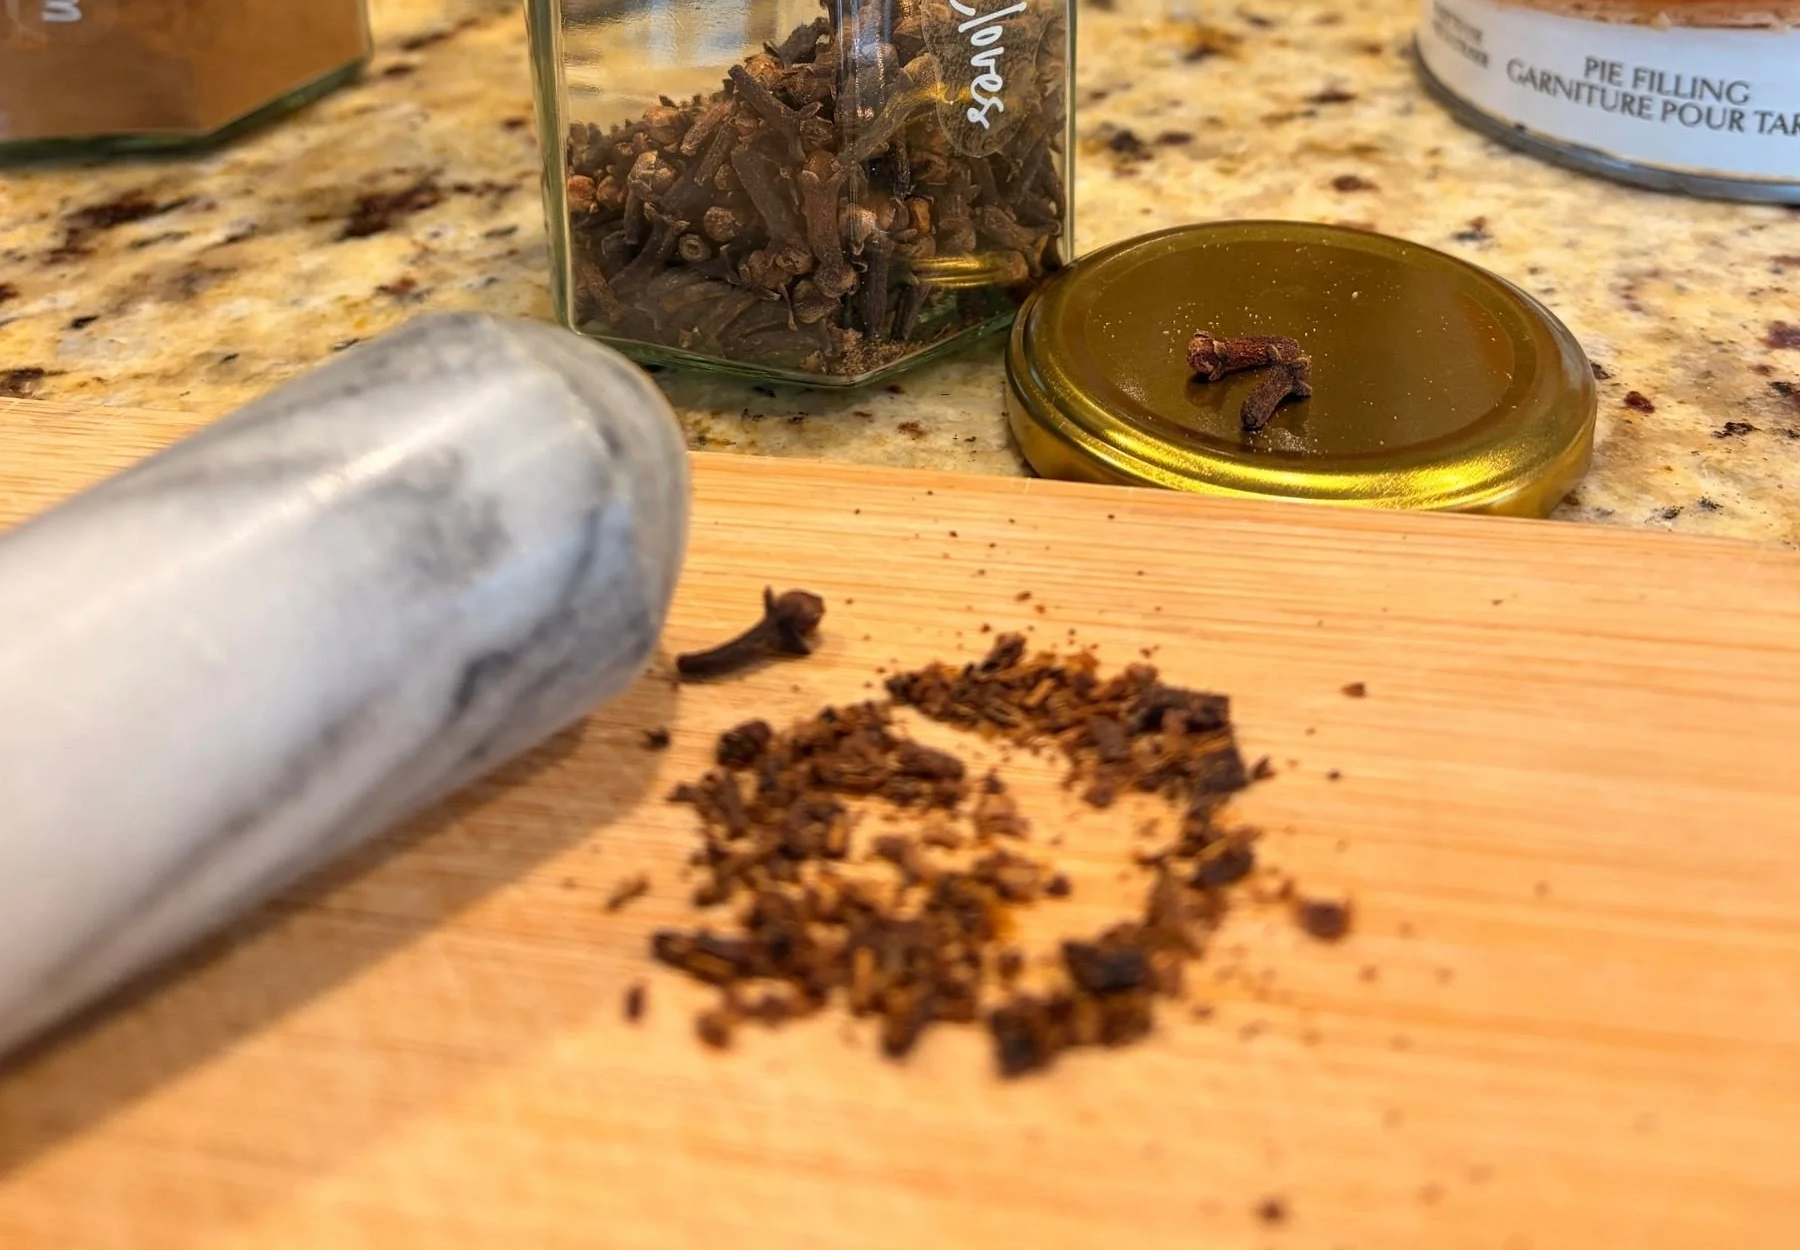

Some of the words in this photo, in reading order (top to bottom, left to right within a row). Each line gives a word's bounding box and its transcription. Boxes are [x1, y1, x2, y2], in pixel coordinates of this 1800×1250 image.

[1505, 57, 1654, 121] GARNITURE
[1659, 101, 1746, 134] POUR
[1583, 55, 1625, 88] PIE
[1631, 66, 1750, 106] FILLING
